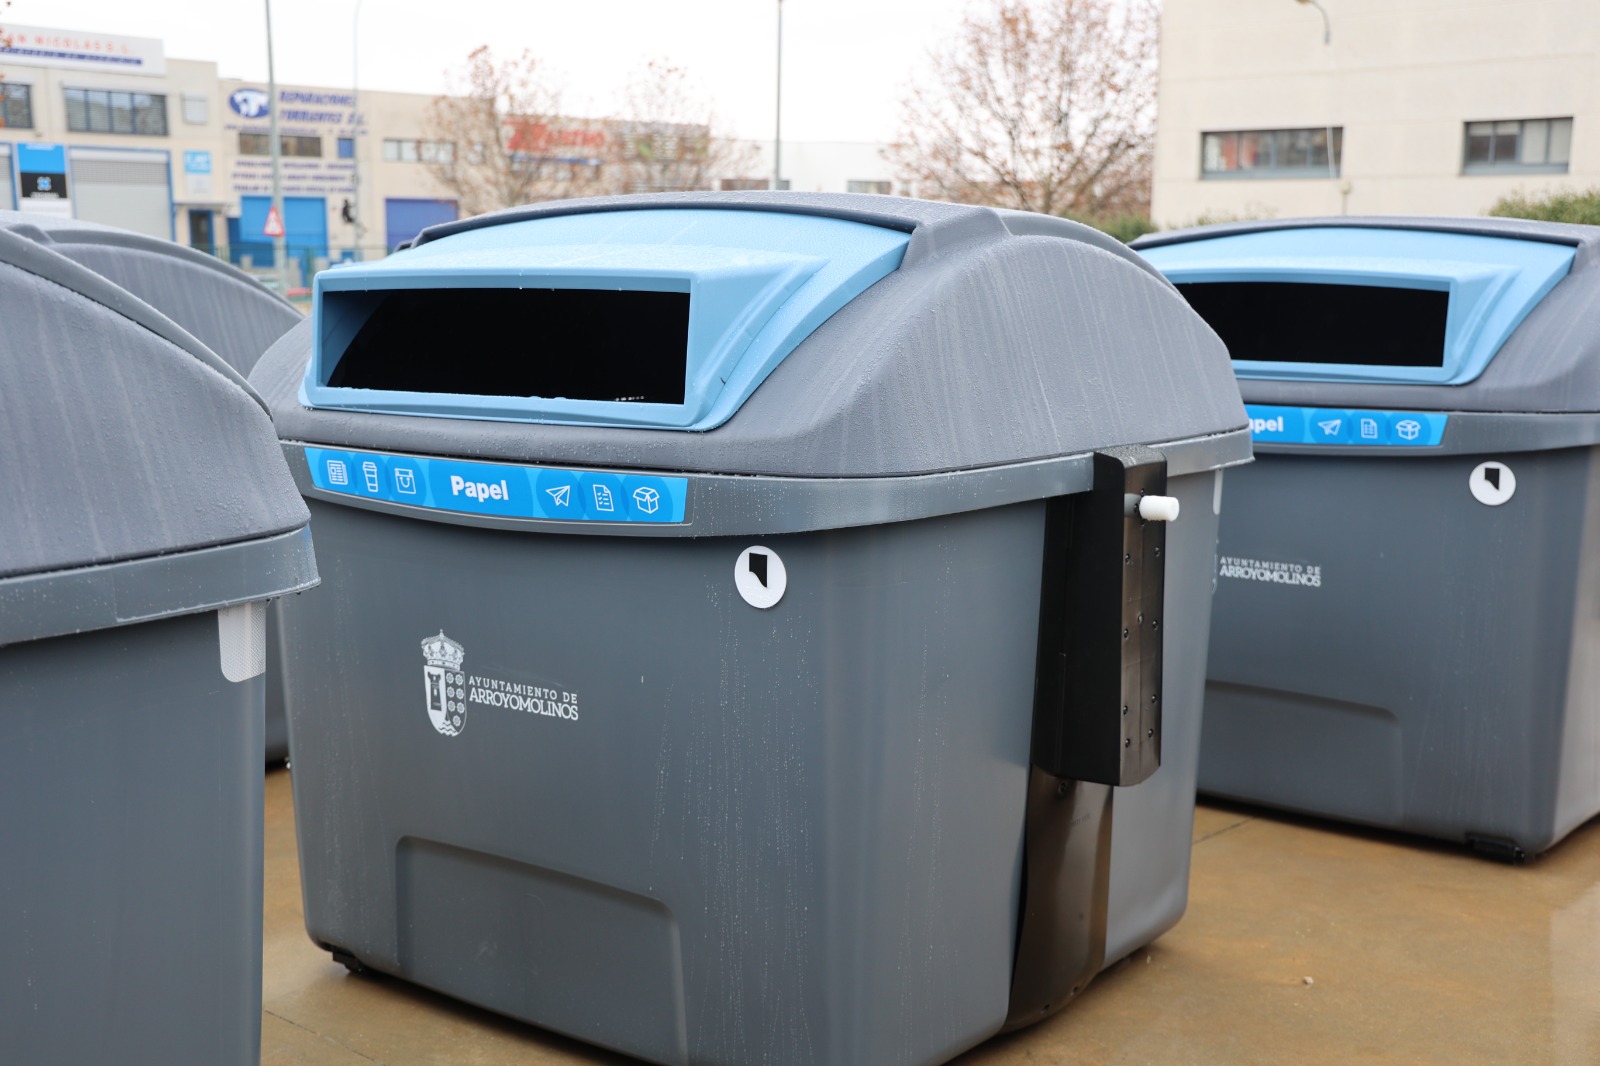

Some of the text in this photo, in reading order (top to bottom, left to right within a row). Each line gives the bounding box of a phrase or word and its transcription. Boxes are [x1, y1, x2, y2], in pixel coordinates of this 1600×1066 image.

[450, 474, 509, 503] Papel
[1219, 564, 1322, 588] ARROYOMOLINOS
[1220, 556, 1321, 575] AYUNTAMIENTO DE
[468, 675, 578, 704] AYUNTAMIENTO DE
[469, 687, 579, 721] ARROYOMOLINOS
